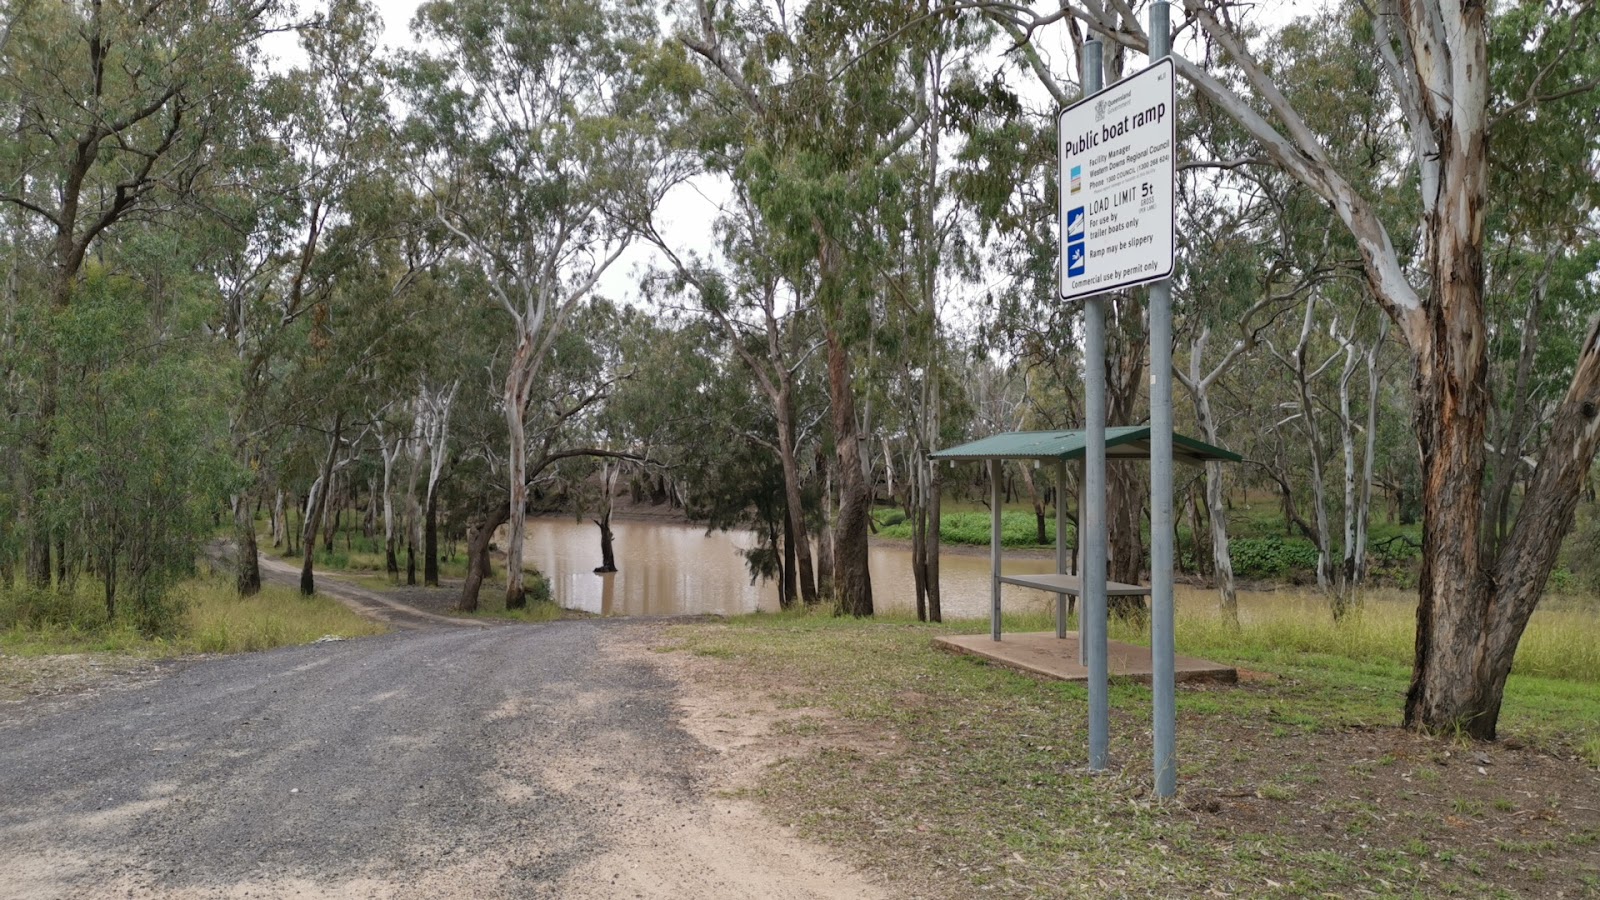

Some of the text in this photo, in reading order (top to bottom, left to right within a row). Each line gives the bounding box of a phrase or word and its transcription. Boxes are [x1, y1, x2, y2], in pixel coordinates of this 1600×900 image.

[1107, 90, 1132, 108] Queensland
[1066, 102, 1165, 159] Public boat ramp
[1089, 145, 1131, 167] Facility Manager
[1090, 139, 1170, 178] Western Downs Regional Council
[1089, 179, 1104, 190] Phone
[1106, 174, 1116, 184] 1300
[1116, 168, 1136, 180] COUNCIL
[1089, 182, 1154, 216] LOAD LIMIT 5t
[1140, 196, 1154, 206] GROSS
[1090, 212, 1118, 228] For use by
[1090, 218, 1139, 240] trailer boats only
[1090, 234, 1154, 258] Ramp may be slippery
[1072, 260, 1158, 289] Commercial use by permit only
